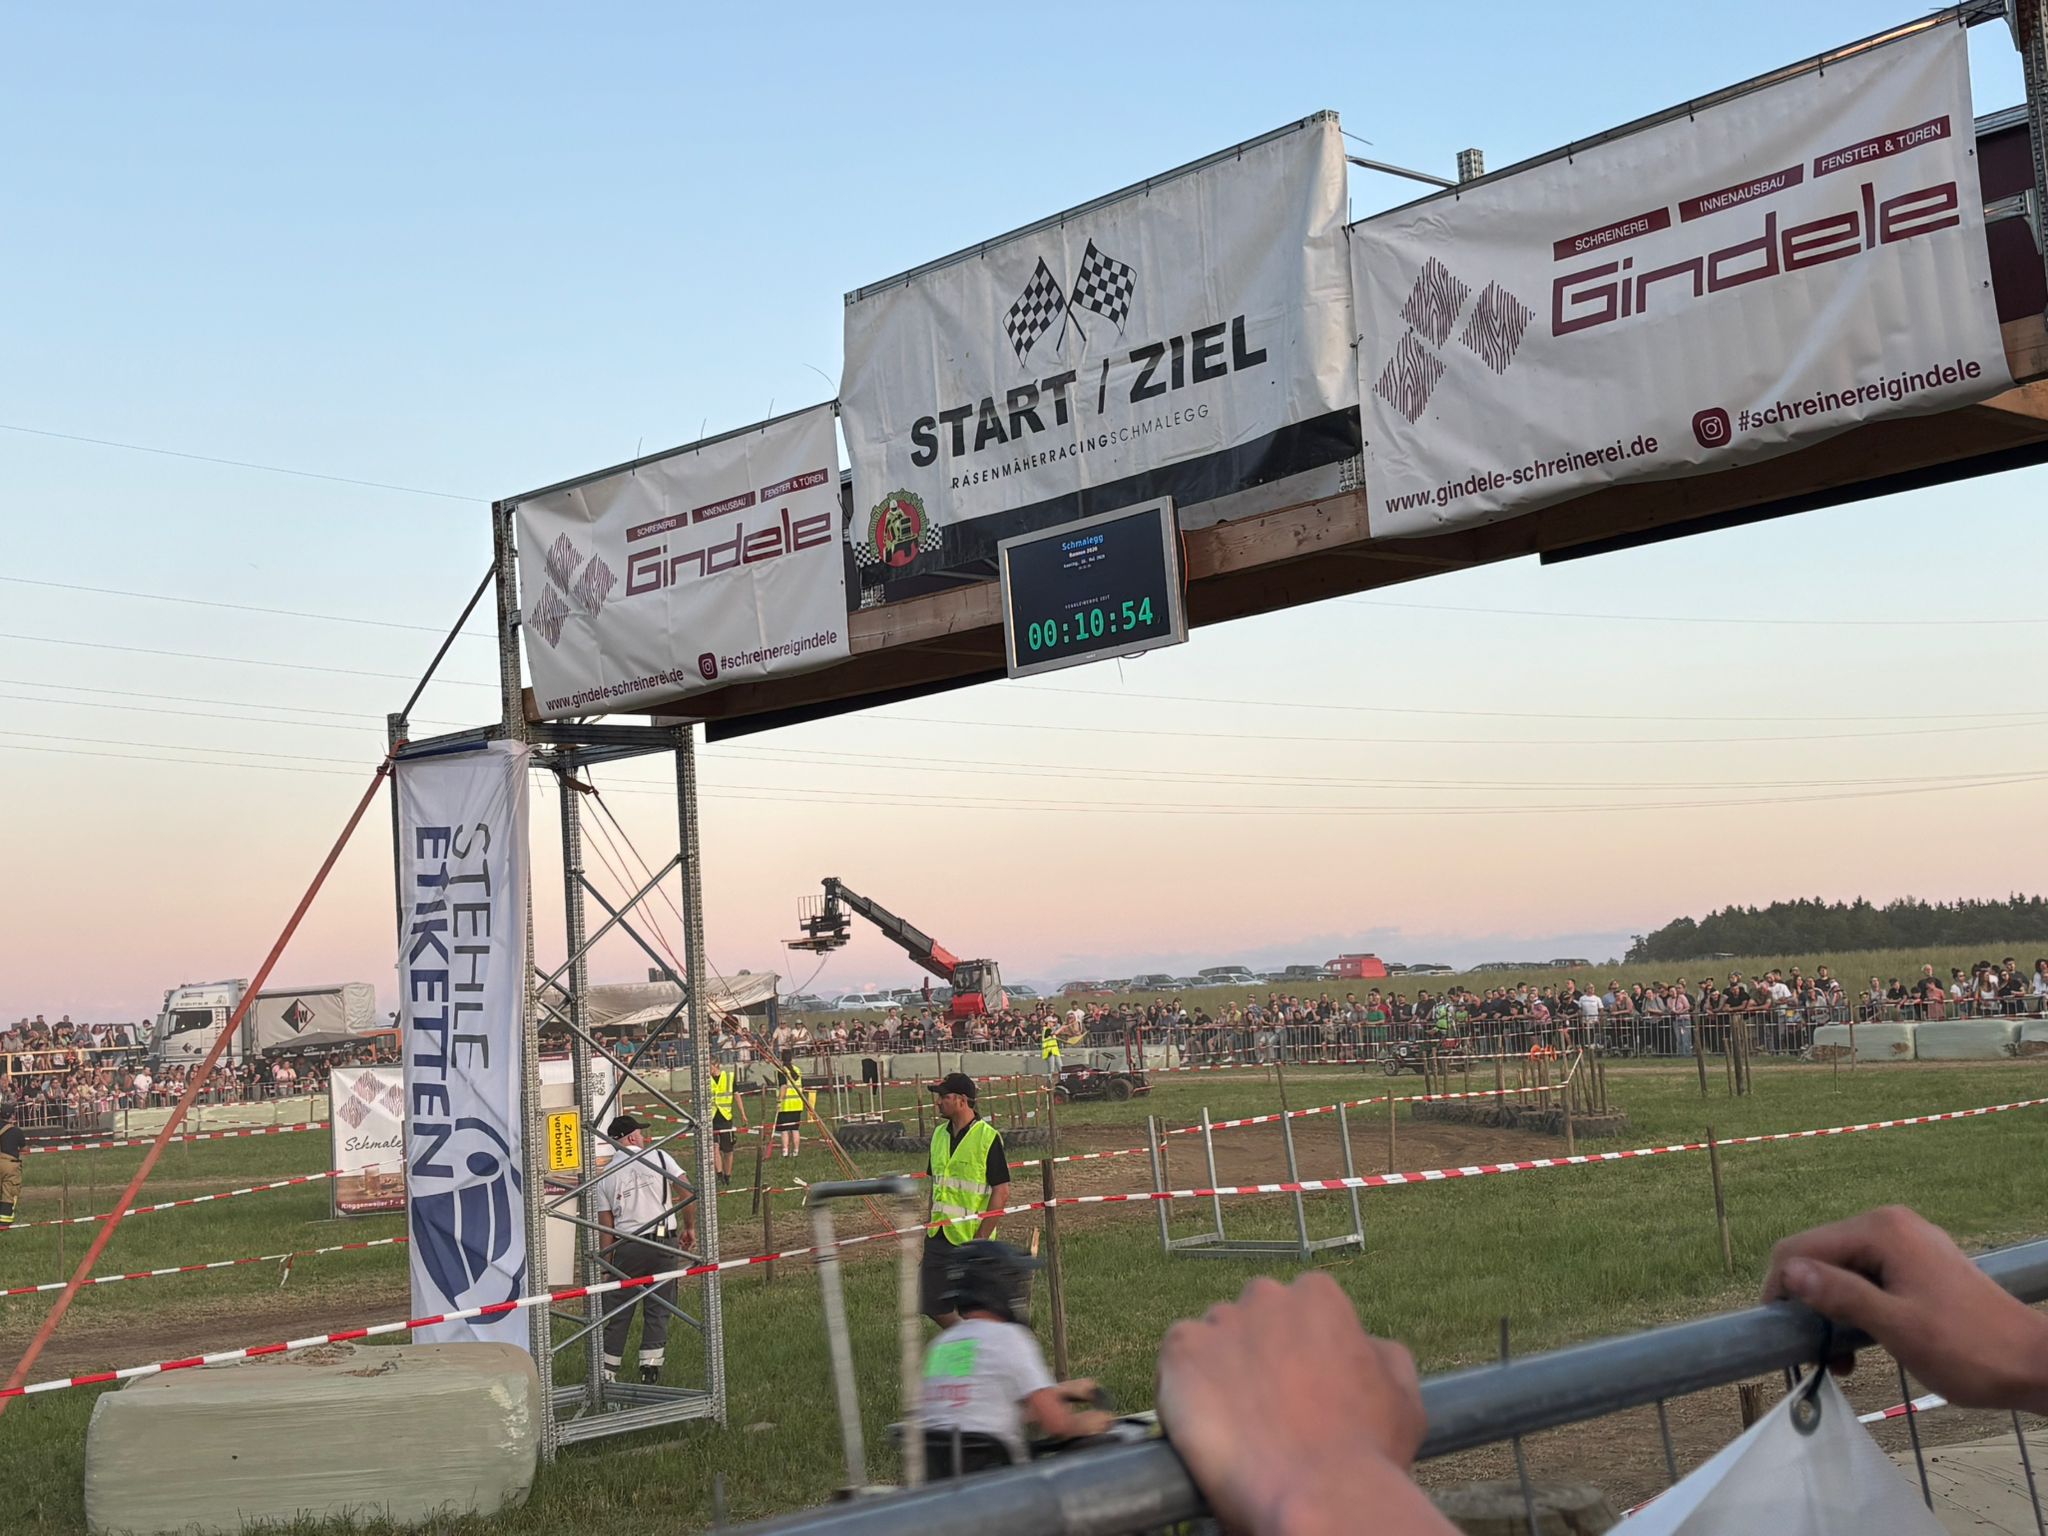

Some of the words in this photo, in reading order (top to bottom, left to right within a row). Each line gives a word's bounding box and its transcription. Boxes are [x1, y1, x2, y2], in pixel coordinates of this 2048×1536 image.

[1821, 143, 1880, 171] FENSTER
[1884, 138, 1895, 153] &
[1897, 123, 1942, 148] TÜREN
[1699, 175, 1786, 213] INNENAUSBAU
[1574, 218, 1649, 251] SCHREINEREI
[1552, 181, 1960, 337] Gindele
[910, 369, 1076, 468] START
[1129, 314, 1268, 404] ZIEL
[1737, 358, 1982, 432] #schreinereigindele
[764, 481, 791, 499] FENSTER
[799, 473, 824, 488] TÜREN
[1385, 433, 1659, 514] www.gindele-schreinerei.de
[637, 519, 677, 537] SCHREINEREI
[702, 497, 747, 518] INNENAUSBAU
[626, 508, 832, 597] Gindele
[1061, 534, 1104, 551] Schmalegg
[1028, 597, 1153, 650] 00:10:54
[720, 630, 838, 670] #schreinereigindele
[546, 668, 684, 712] www.gindele-schreinerei.de
[451, 822, 491, 1069] STEHLE
[410, 825, 453, 1179] ETIKETTEN
[554, 1115, 564, 1168] verboten!
[564, 1124, 573, 1158] Zutritt
